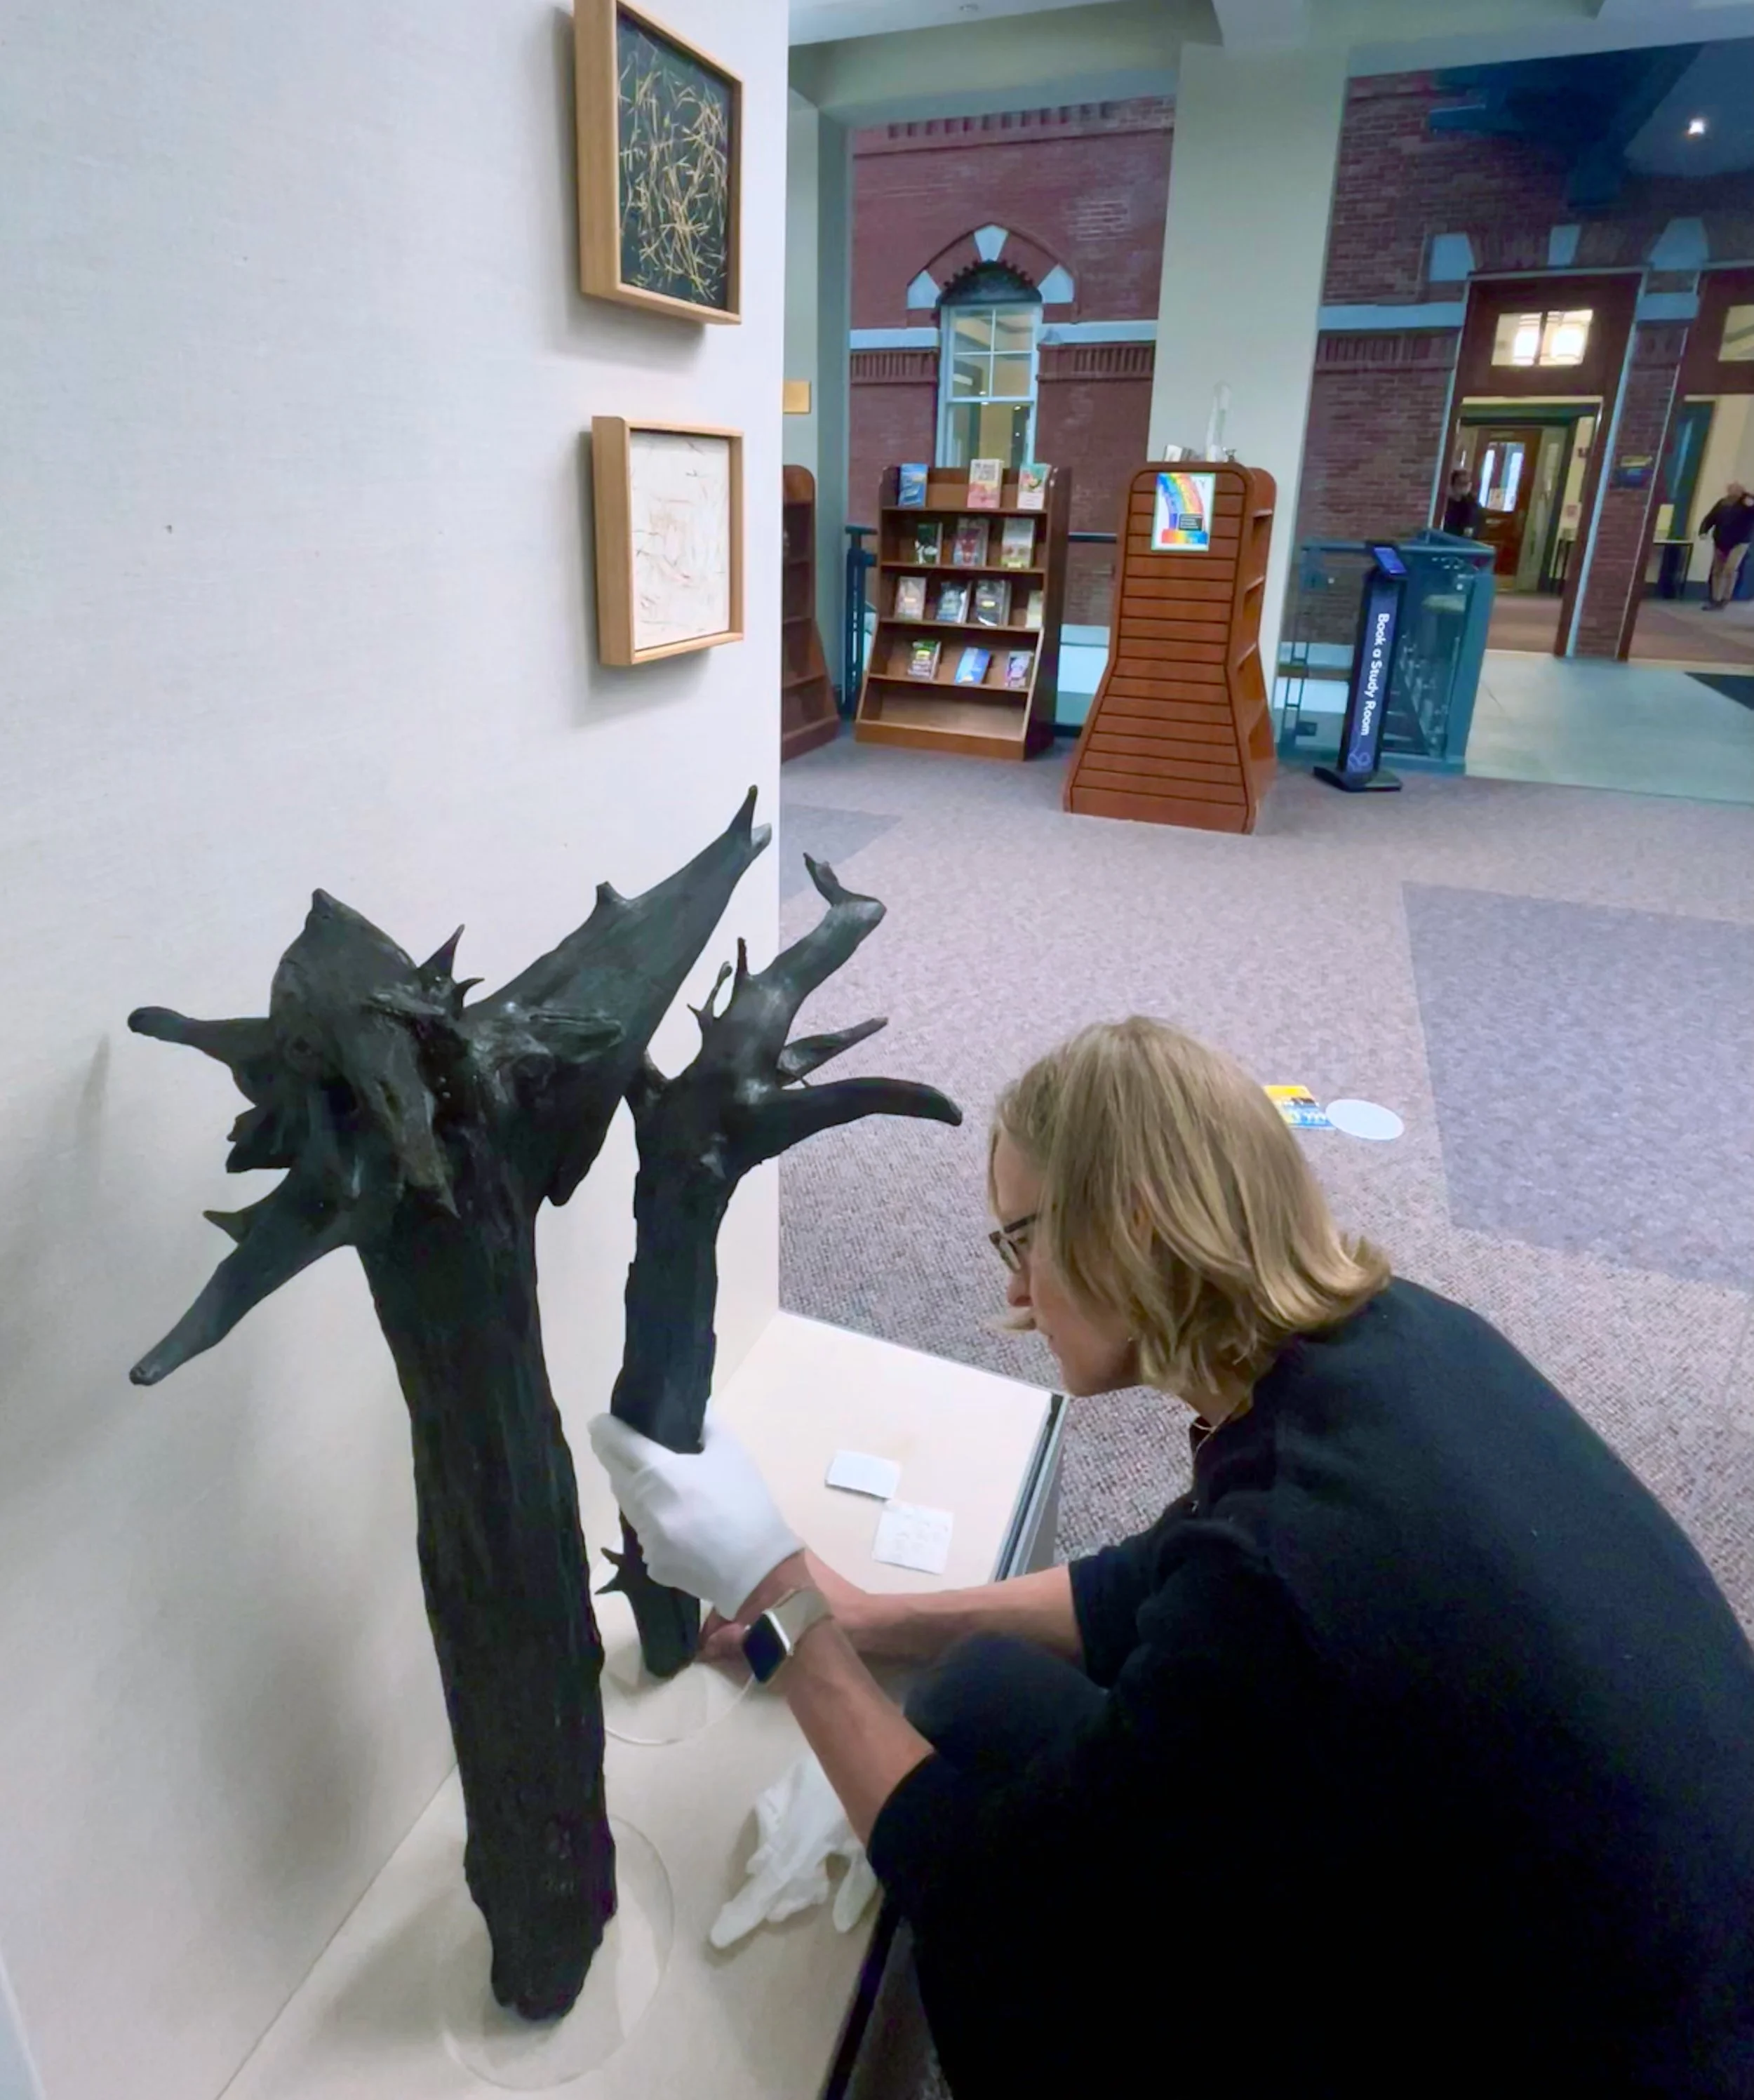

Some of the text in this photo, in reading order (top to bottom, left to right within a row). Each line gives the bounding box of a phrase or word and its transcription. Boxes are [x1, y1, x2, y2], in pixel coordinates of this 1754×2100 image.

[1360, 613, 1390, 736] Book a Study Room
